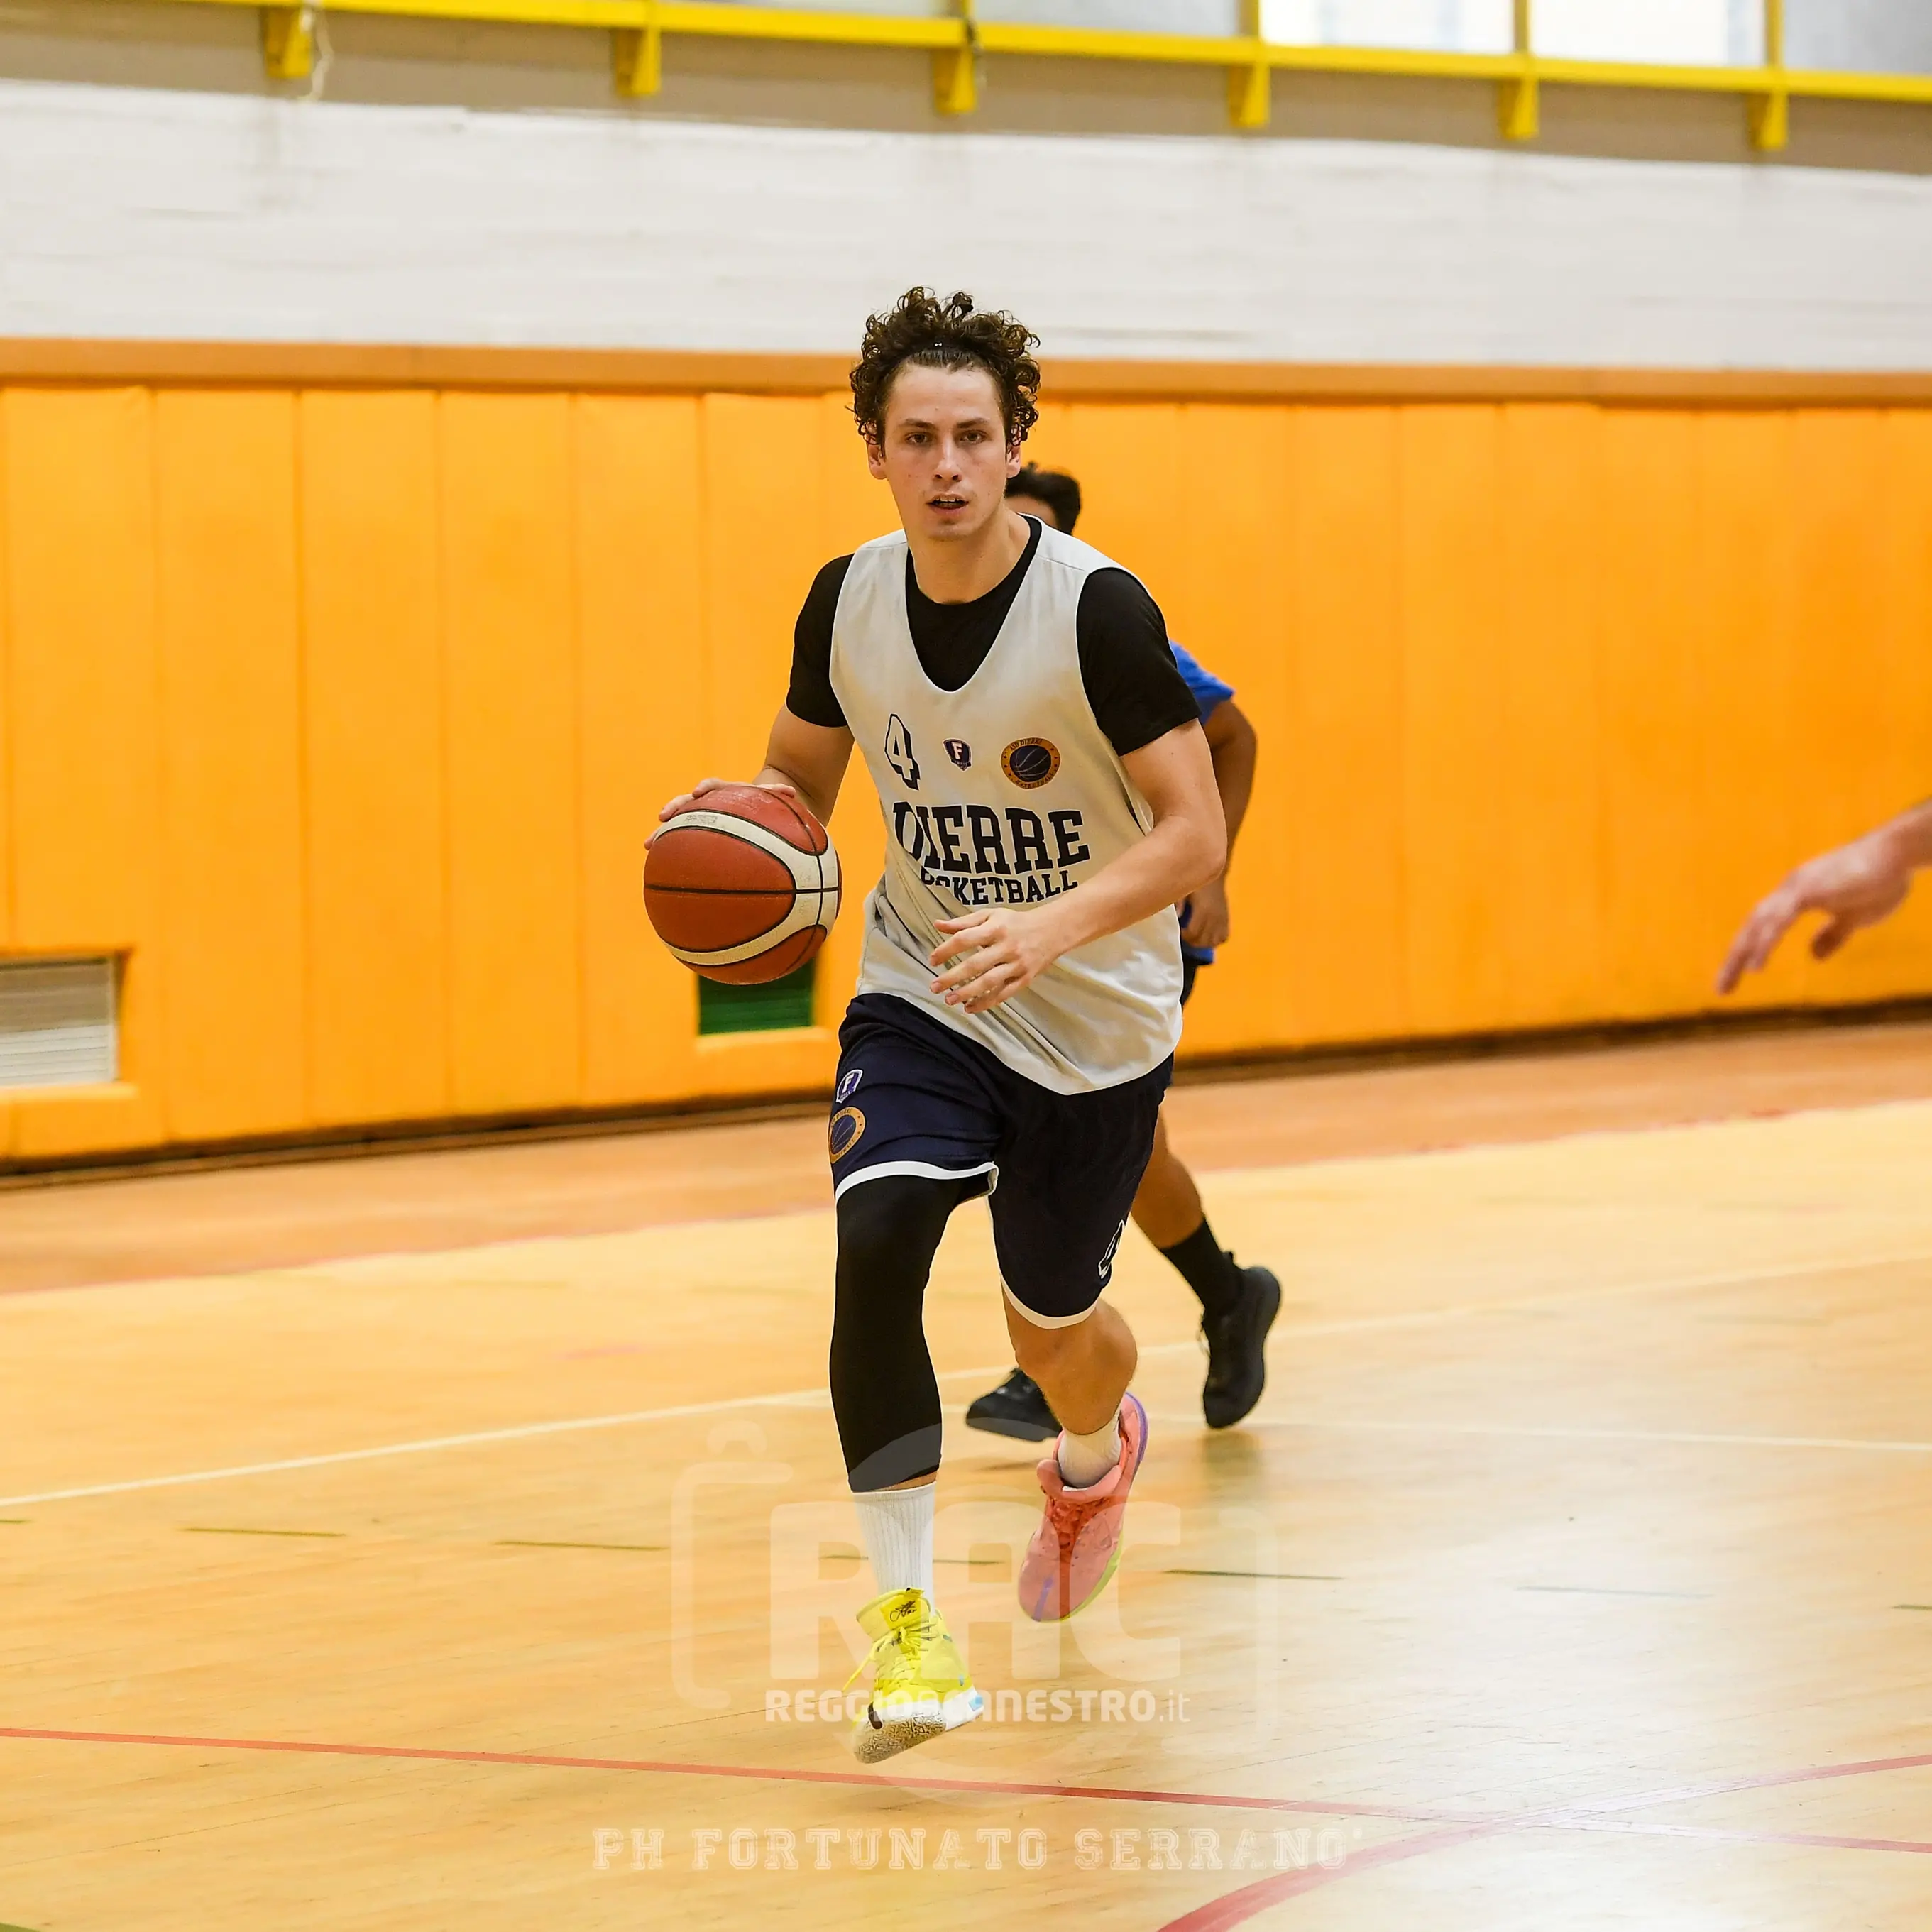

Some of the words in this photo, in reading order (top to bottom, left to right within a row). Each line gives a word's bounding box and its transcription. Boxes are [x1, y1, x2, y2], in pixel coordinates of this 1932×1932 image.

[884, 713, 921, 791] 4
[951, 741, 962, 760] F
[892, 801, 1091, 875] DIERRE
